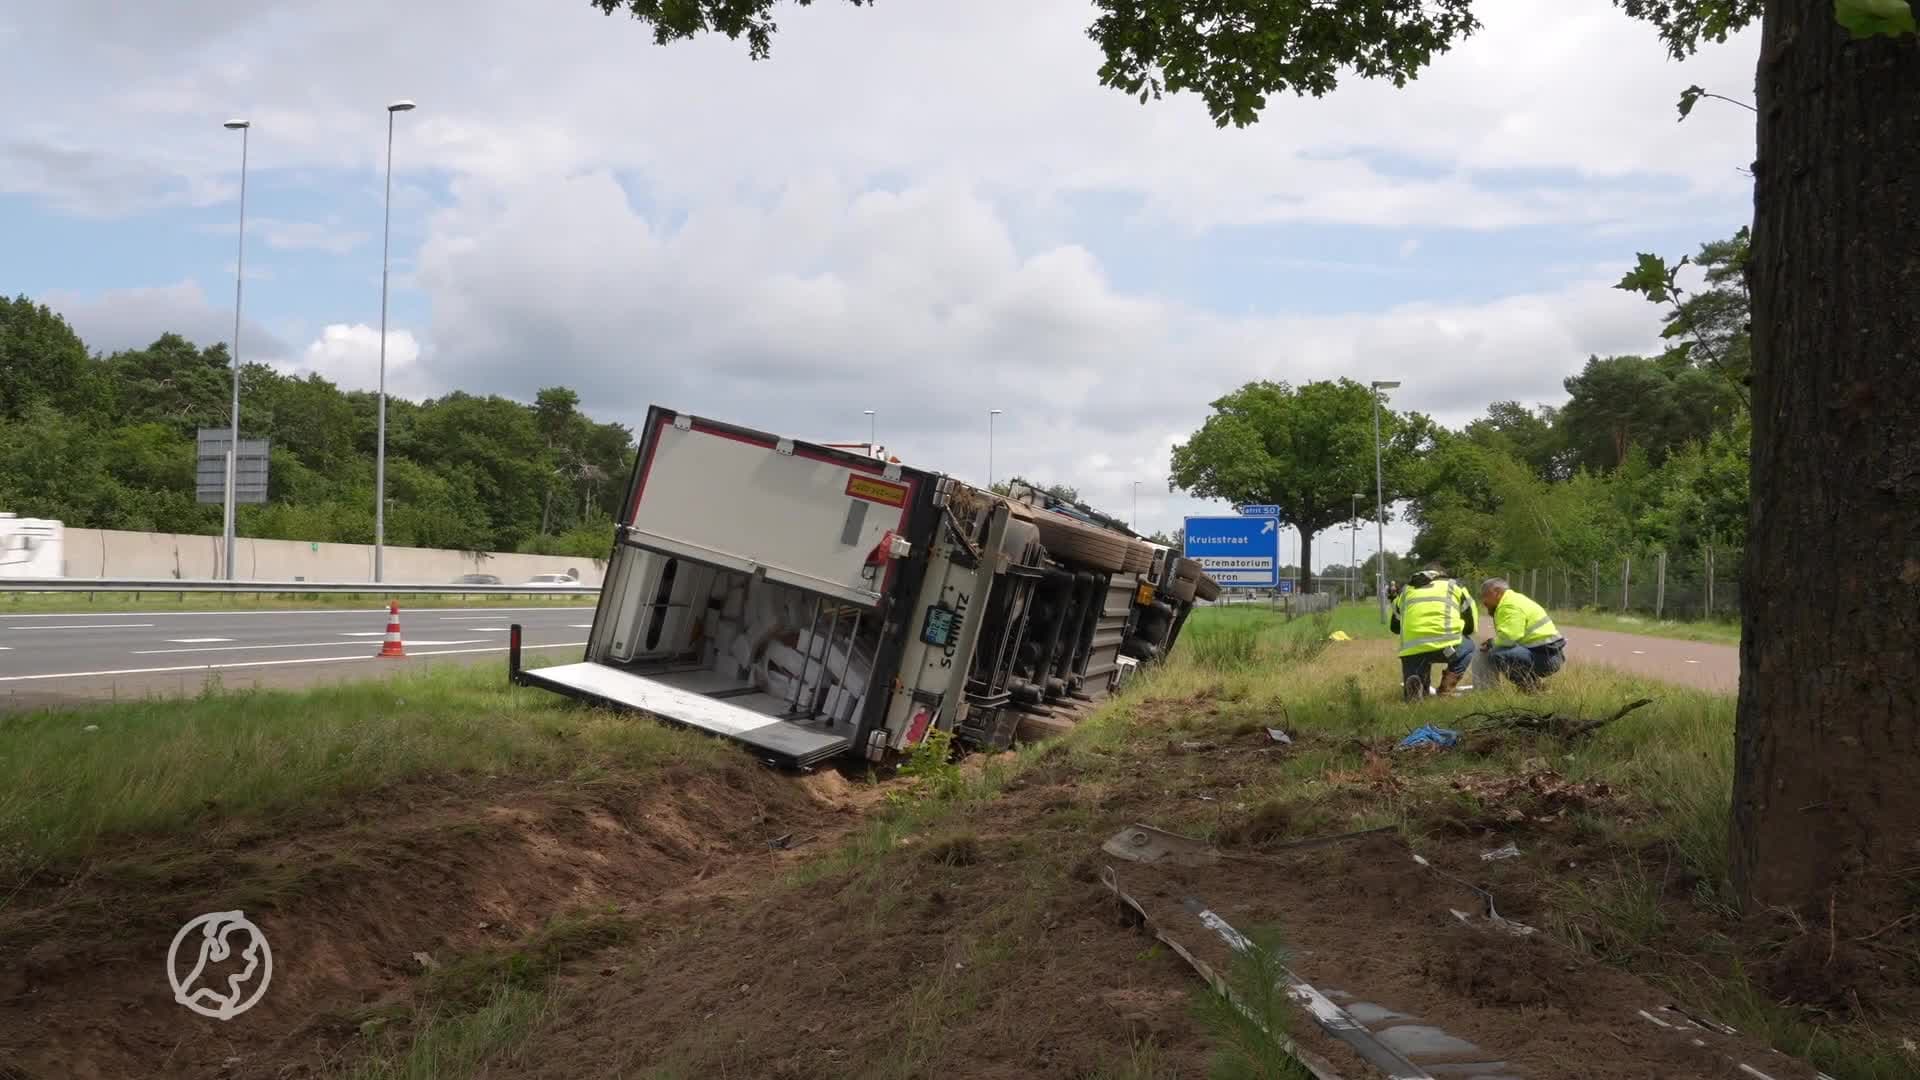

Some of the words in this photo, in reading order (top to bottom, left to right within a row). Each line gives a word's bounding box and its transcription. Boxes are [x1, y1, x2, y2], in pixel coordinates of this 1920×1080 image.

[1189, 536, 1249, 544] Kruisstraat
[1204, 559, 1270, 567] Crematorium
[1208, 573, 1238, 581] otron
[940, 592, 970, 669] SCHMITZ
